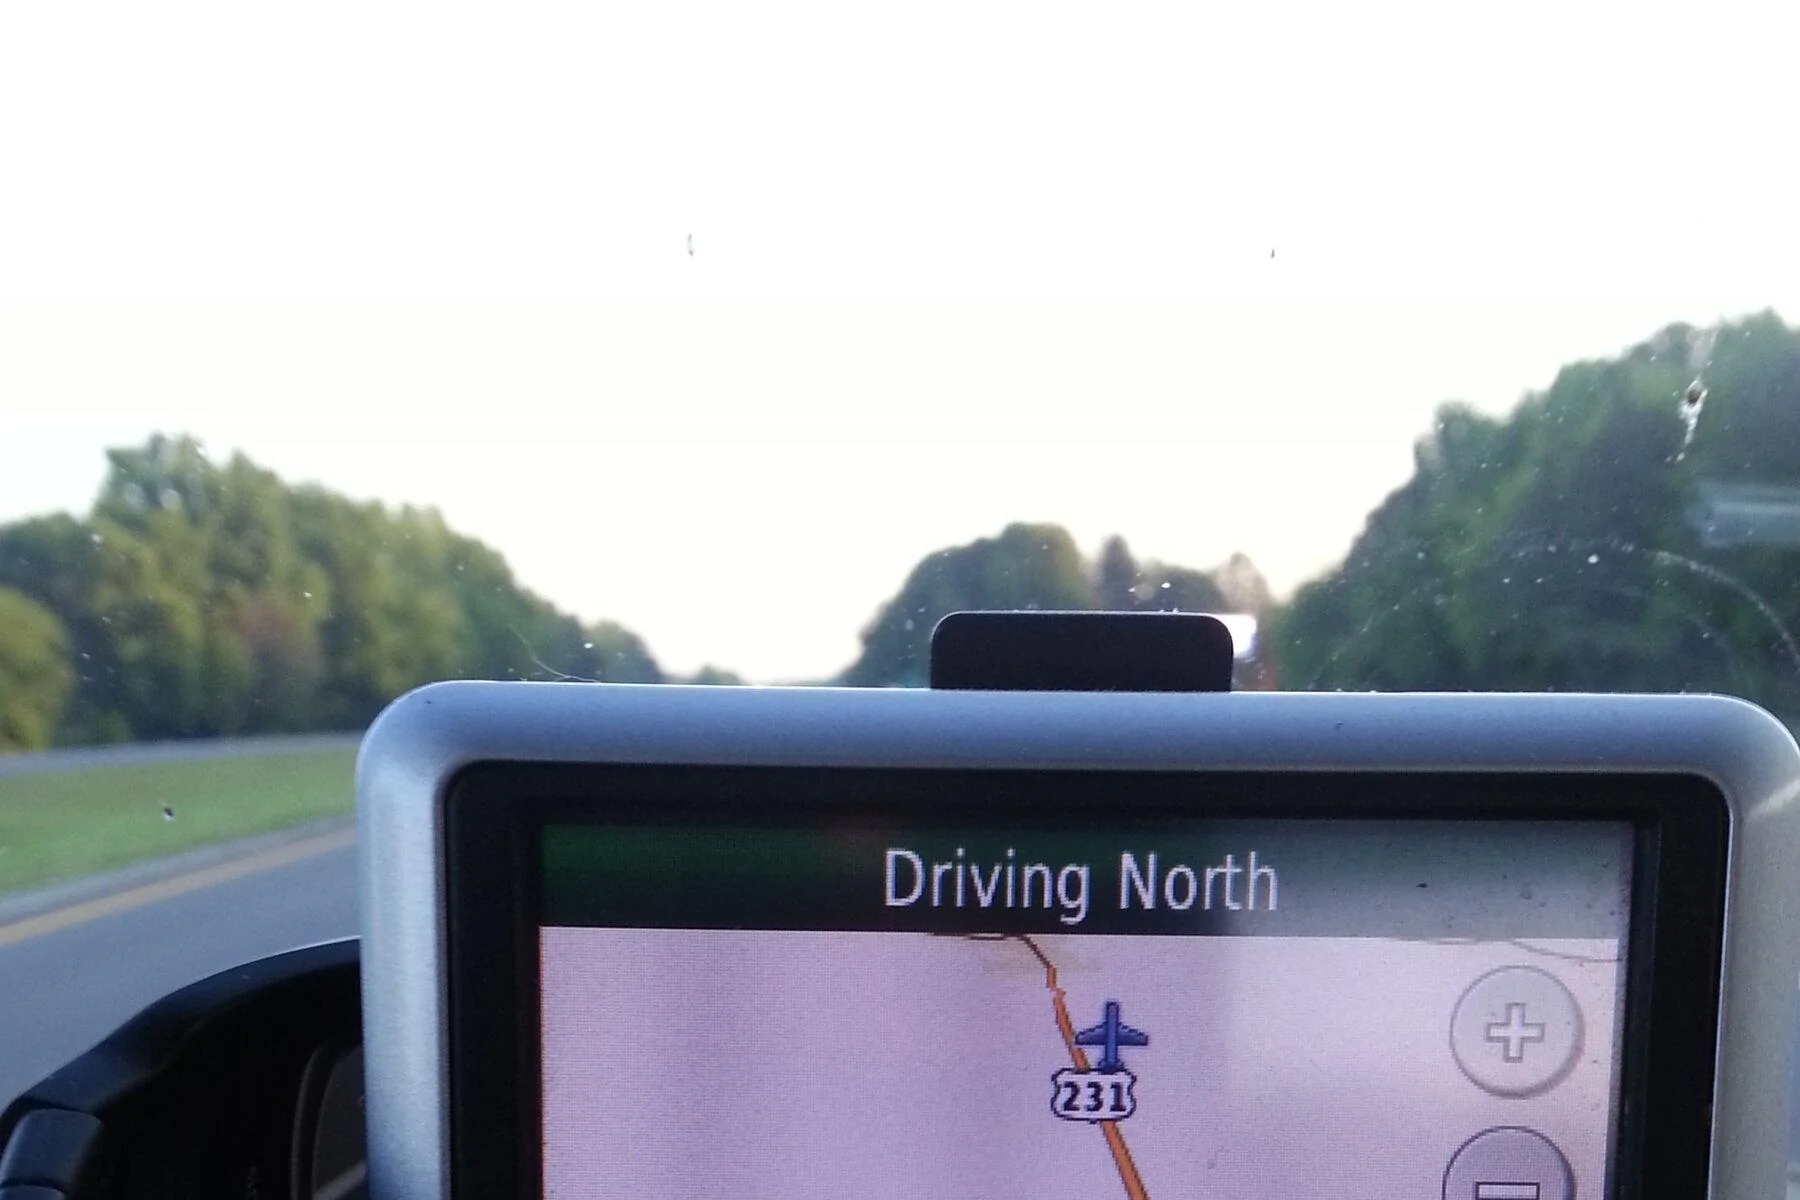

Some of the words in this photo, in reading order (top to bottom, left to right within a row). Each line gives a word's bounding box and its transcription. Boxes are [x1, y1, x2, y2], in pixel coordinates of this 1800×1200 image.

[883, 848, 1091, 925] Driving
[1119, 850, 1280, 914] North
[1060, 1079, 1129, 1116] 231
